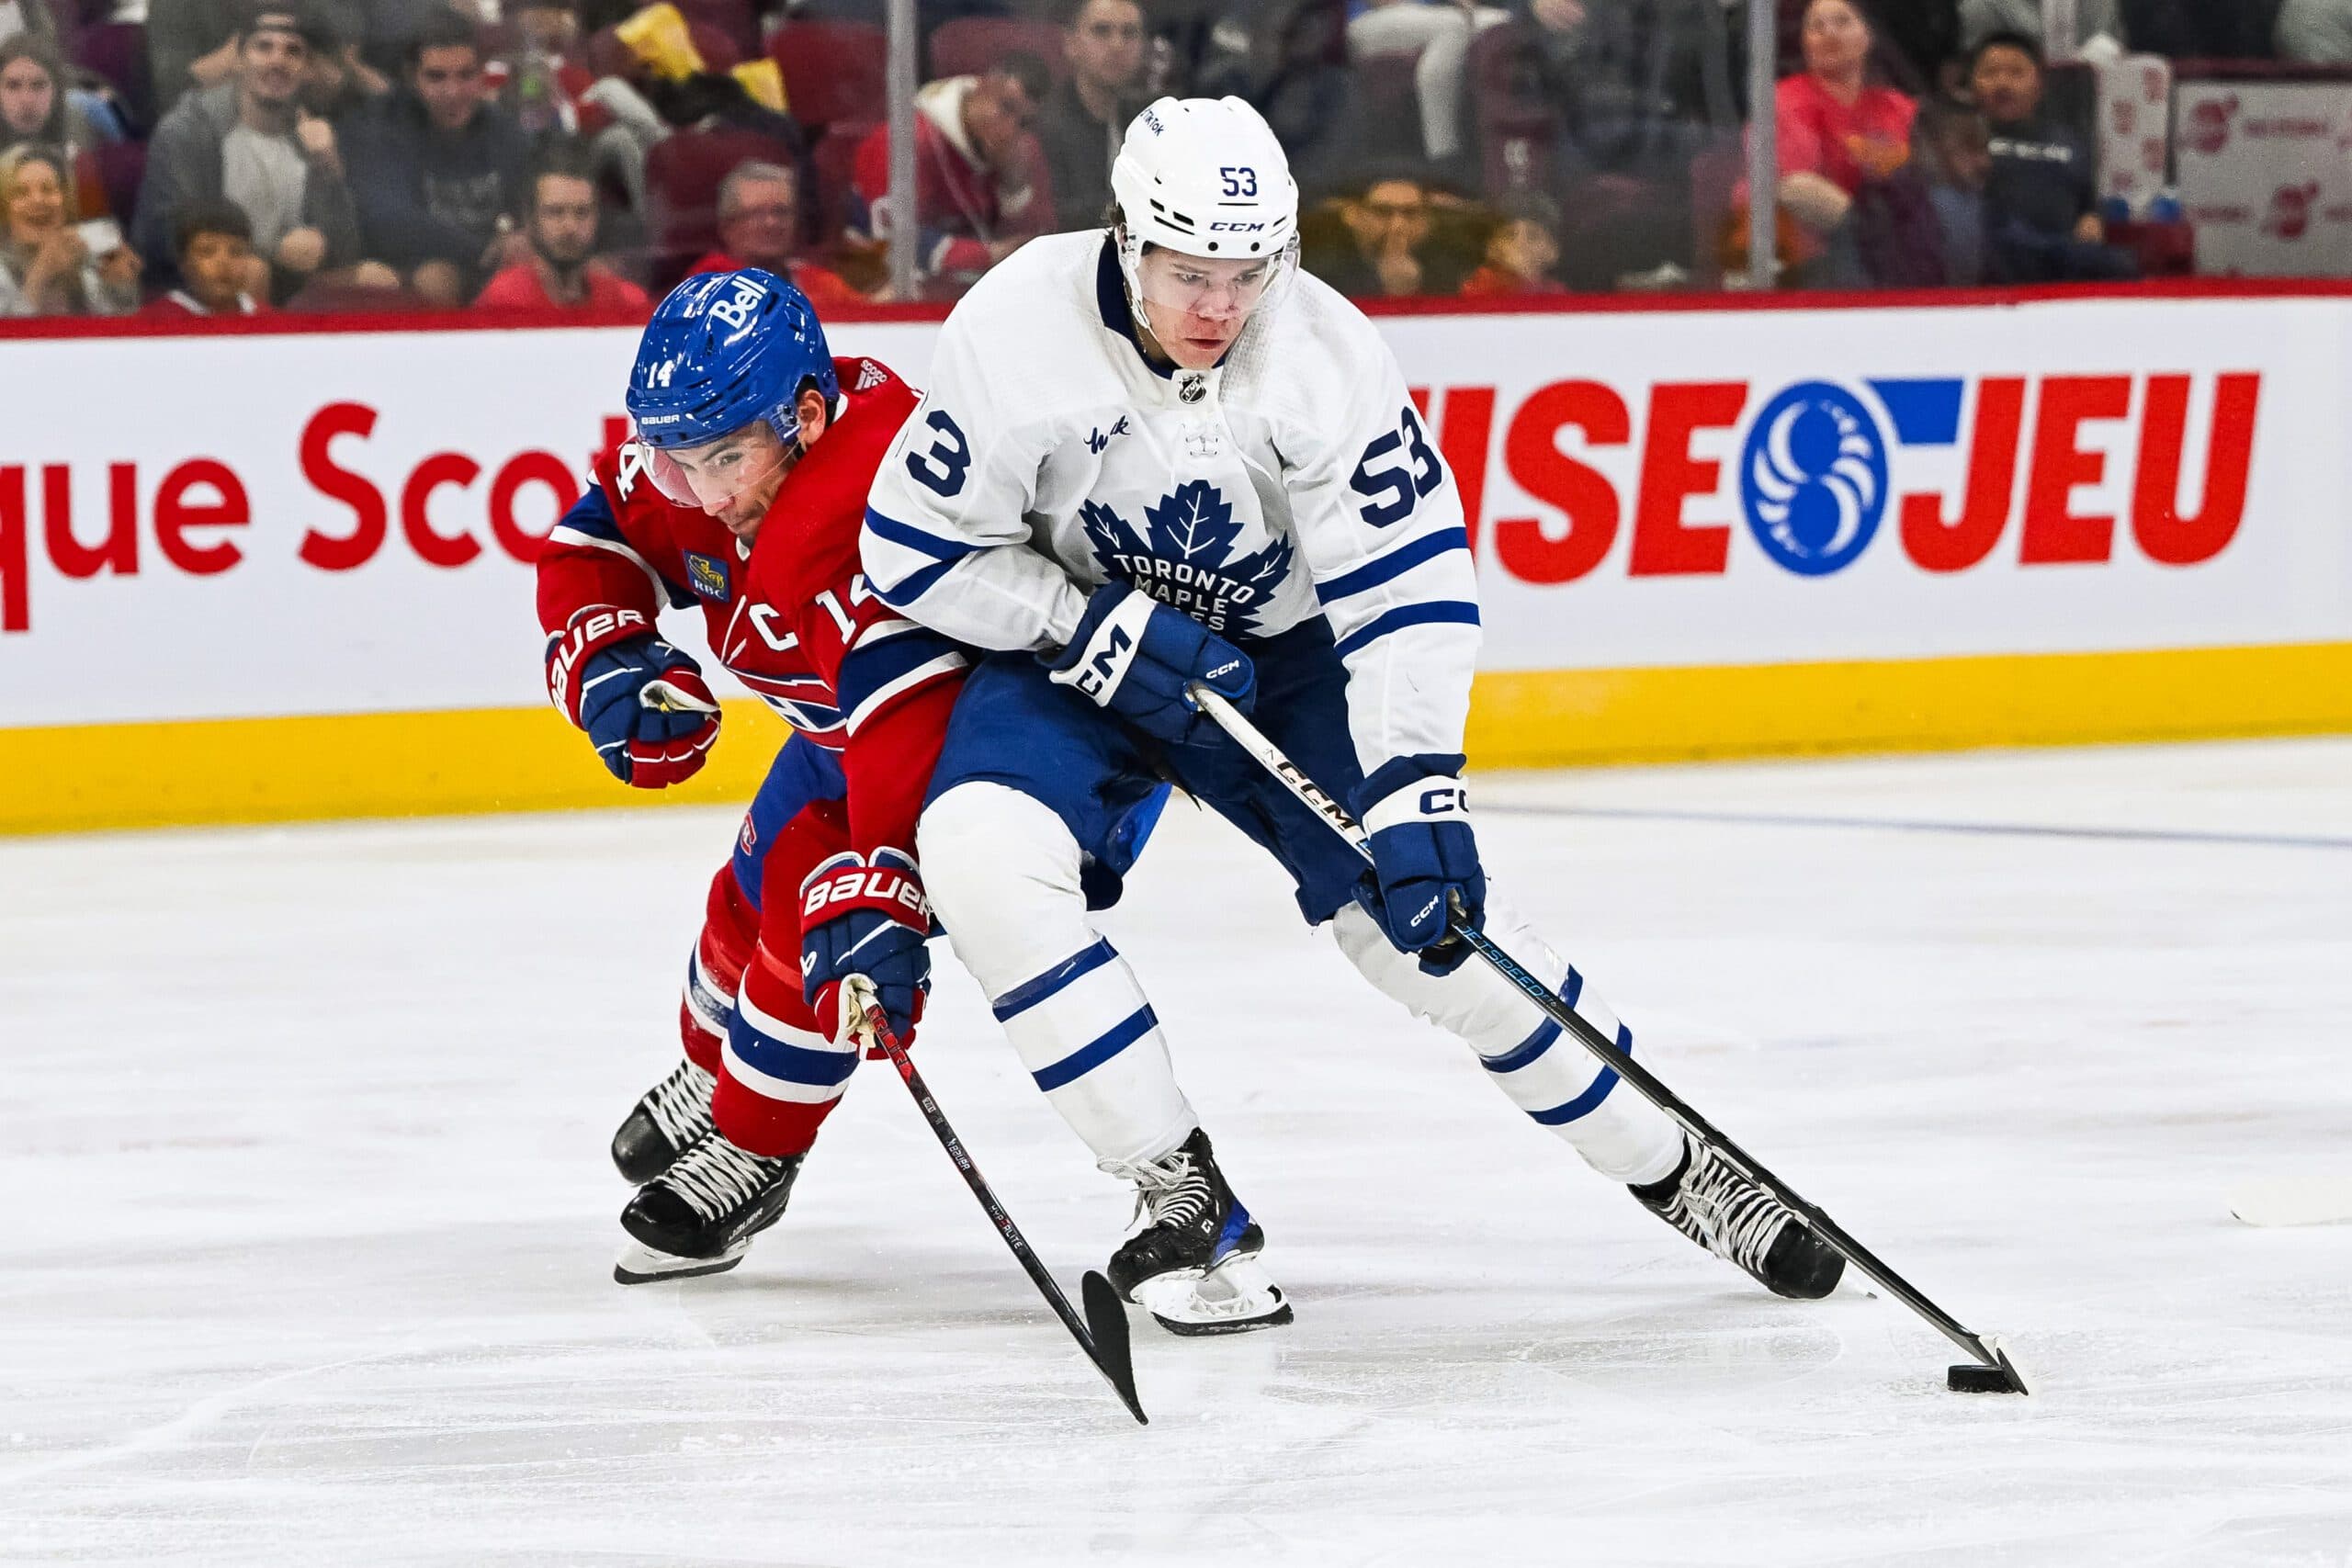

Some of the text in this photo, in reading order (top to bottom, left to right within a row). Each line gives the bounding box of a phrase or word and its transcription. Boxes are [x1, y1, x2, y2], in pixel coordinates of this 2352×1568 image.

[1219, 167, 1258, 197] 53
[1209, 221, 1265, 232] CCM
[708, 275, 771, 330] Bell
[646, 359, 675, 389] 14
[903, 404, 972, 498] 3
[1349, 406, 1442, 529] 53
[297, 400, 629, 572] Sco
[1407, 371, 2260, 588] ISE JEU
[694, 579, 724, 600] RBC
[1113, 554, 1256, 604] TORONTO
[1134, 574, 1229, 615] MAPLE
[749, 604, 799, 652] C
[1205, 659, 1240, 680] CCM
[1276, 761, 1358, 831] CCM
[1409, 895, 1439, 928] CCM
[1459, 924, 1545, 998] JETSPEED
